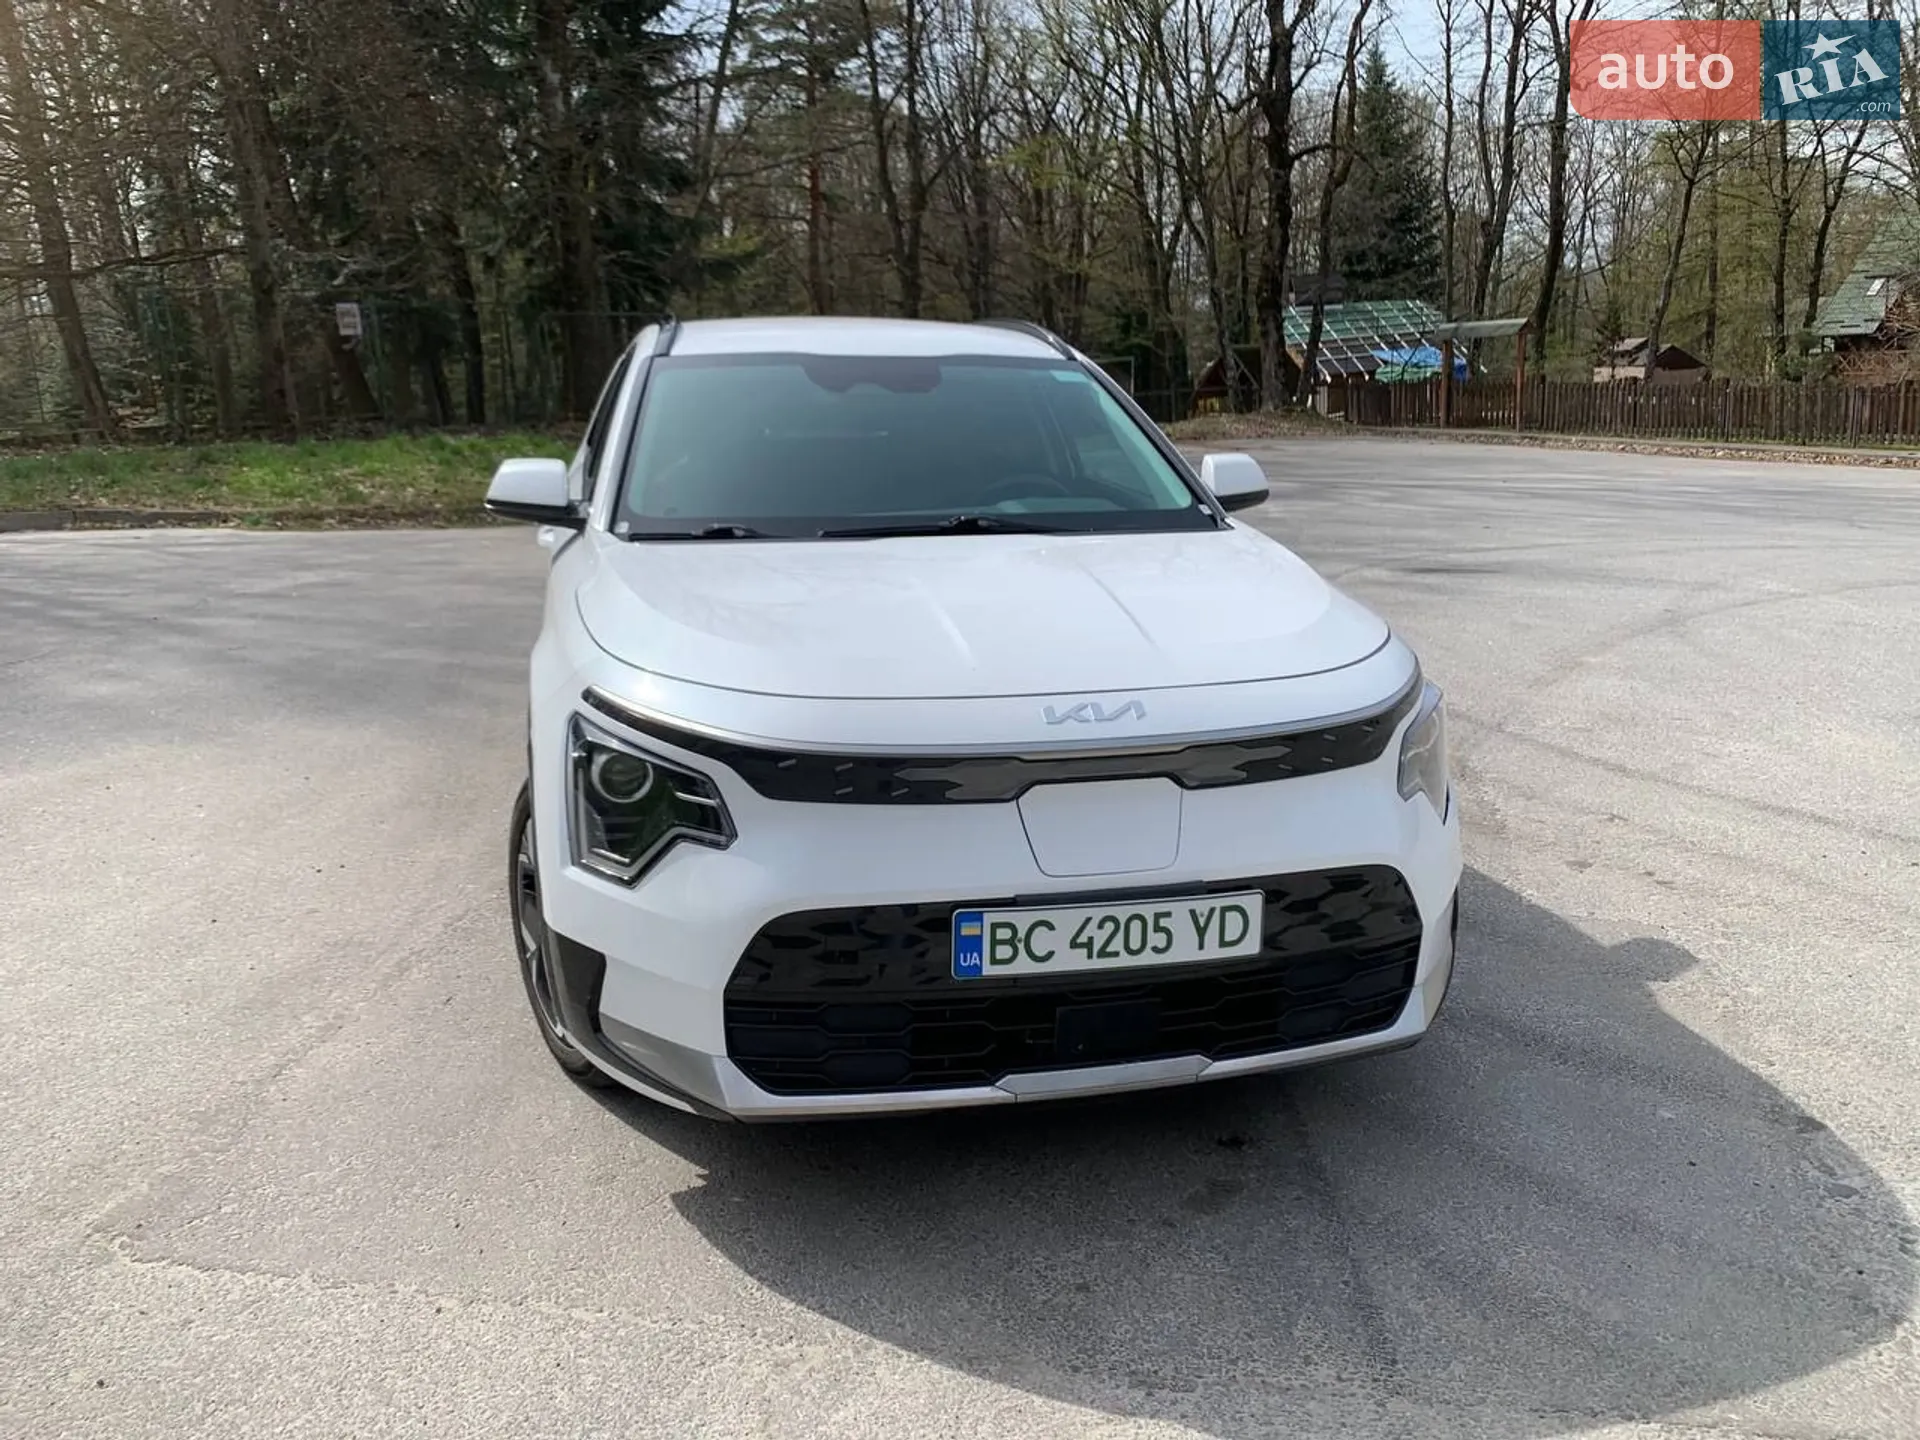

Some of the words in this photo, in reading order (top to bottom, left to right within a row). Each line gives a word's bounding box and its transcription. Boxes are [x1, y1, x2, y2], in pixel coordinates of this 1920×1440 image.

[989, 919, 1056, 966] BC
[1069, 911, 1173, 960] 4205
[1188, 904, 1250, 951] YD
[960, 952, 980, 967] UA
